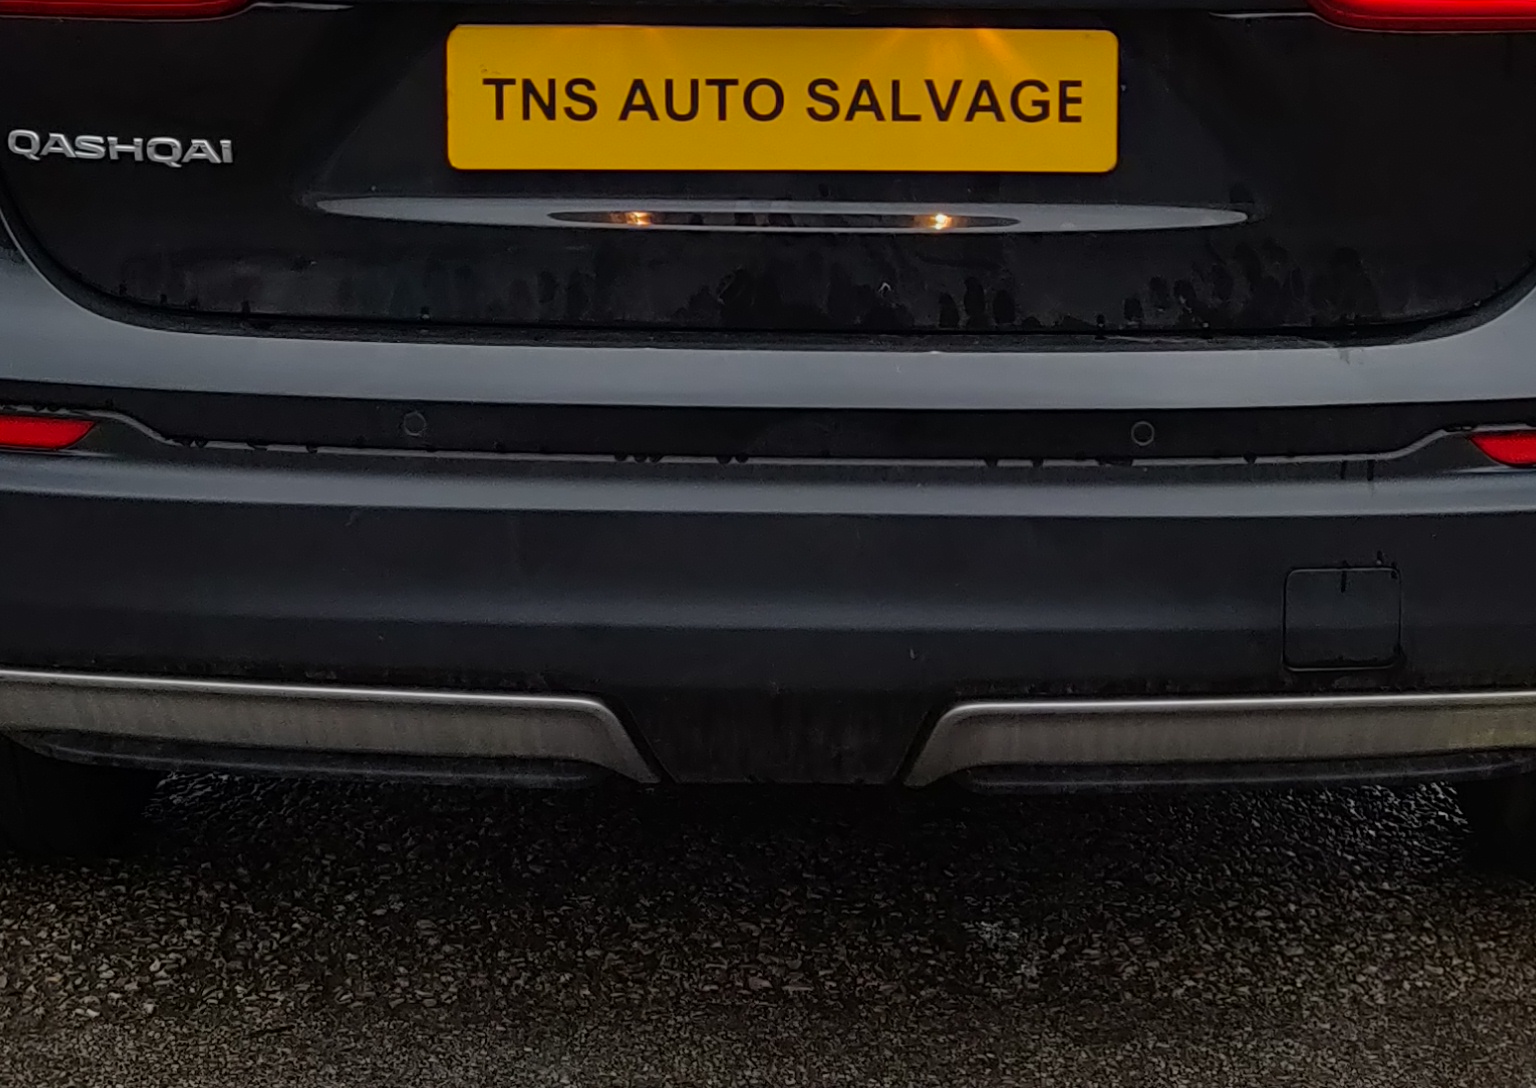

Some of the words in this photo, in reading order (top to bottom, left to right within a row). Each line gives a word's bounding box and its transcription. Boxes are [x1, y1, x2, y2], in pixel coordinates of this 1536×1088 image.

[483, 77, 597, 122] TNS
[618, 77, 784, 122] AUTO
[806, 78, 1082, 124] SALVAGE
[7, 128, 233, 168] QASHQAI
